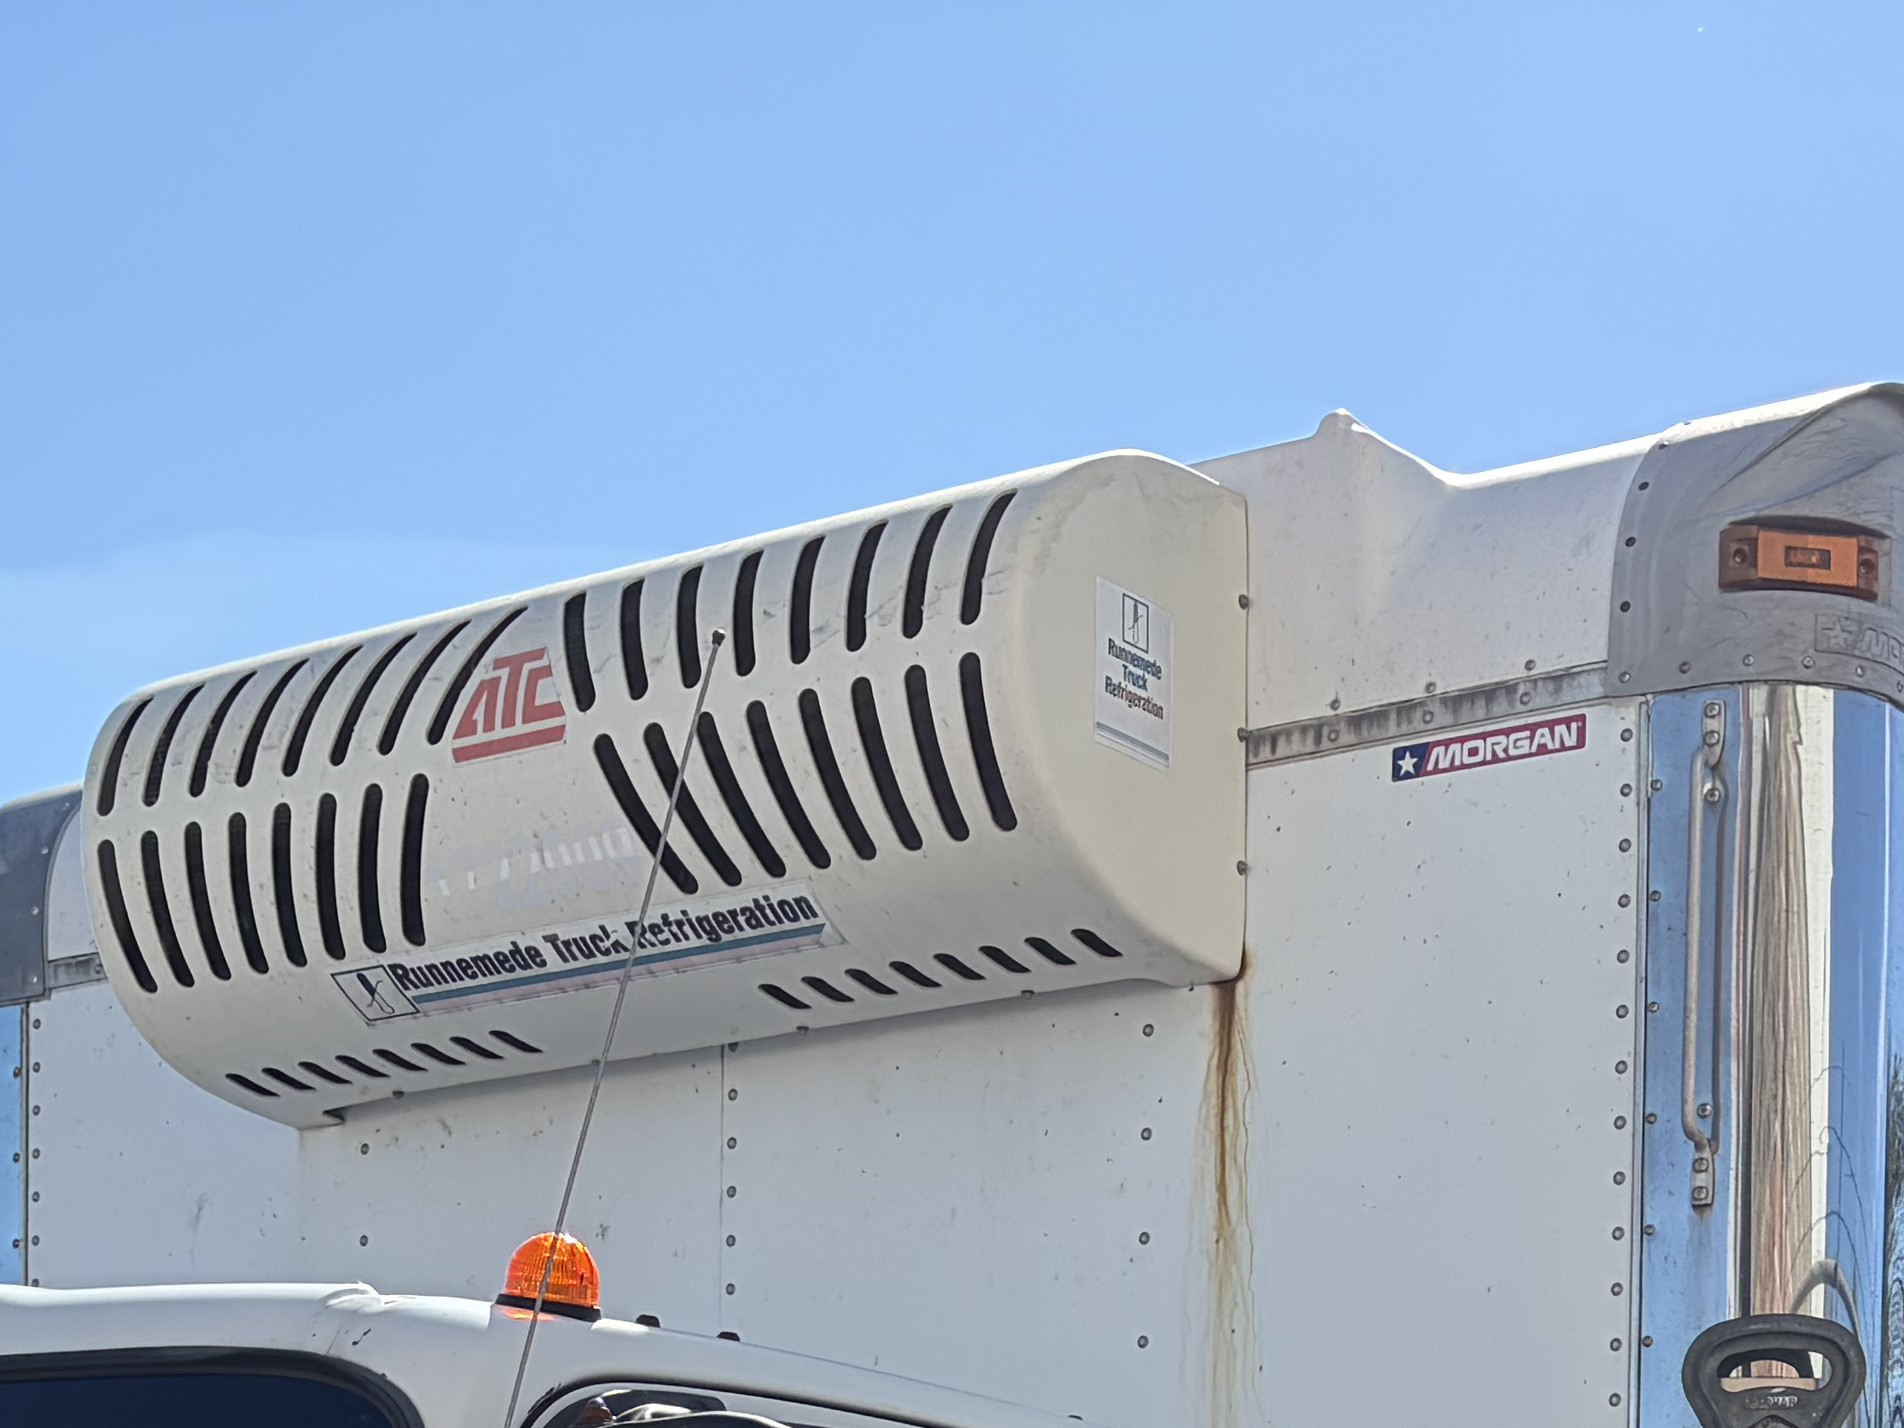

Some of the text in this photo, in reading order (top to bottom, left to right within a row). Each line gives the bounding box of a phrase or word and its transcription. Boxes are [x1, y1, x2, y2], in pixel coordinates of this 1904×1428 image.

[1108, 637, 1162, 680] Runnemede
[1121, 663, 1148, 691] Truck
[452, 646, 566, 740] ATC
[1104, 675, 1164, 720] Refrigeration
[1426, 721, 1578, 771] MORGAN
[388, 893, 819, 992] Runnemede Truck Refrigeration
